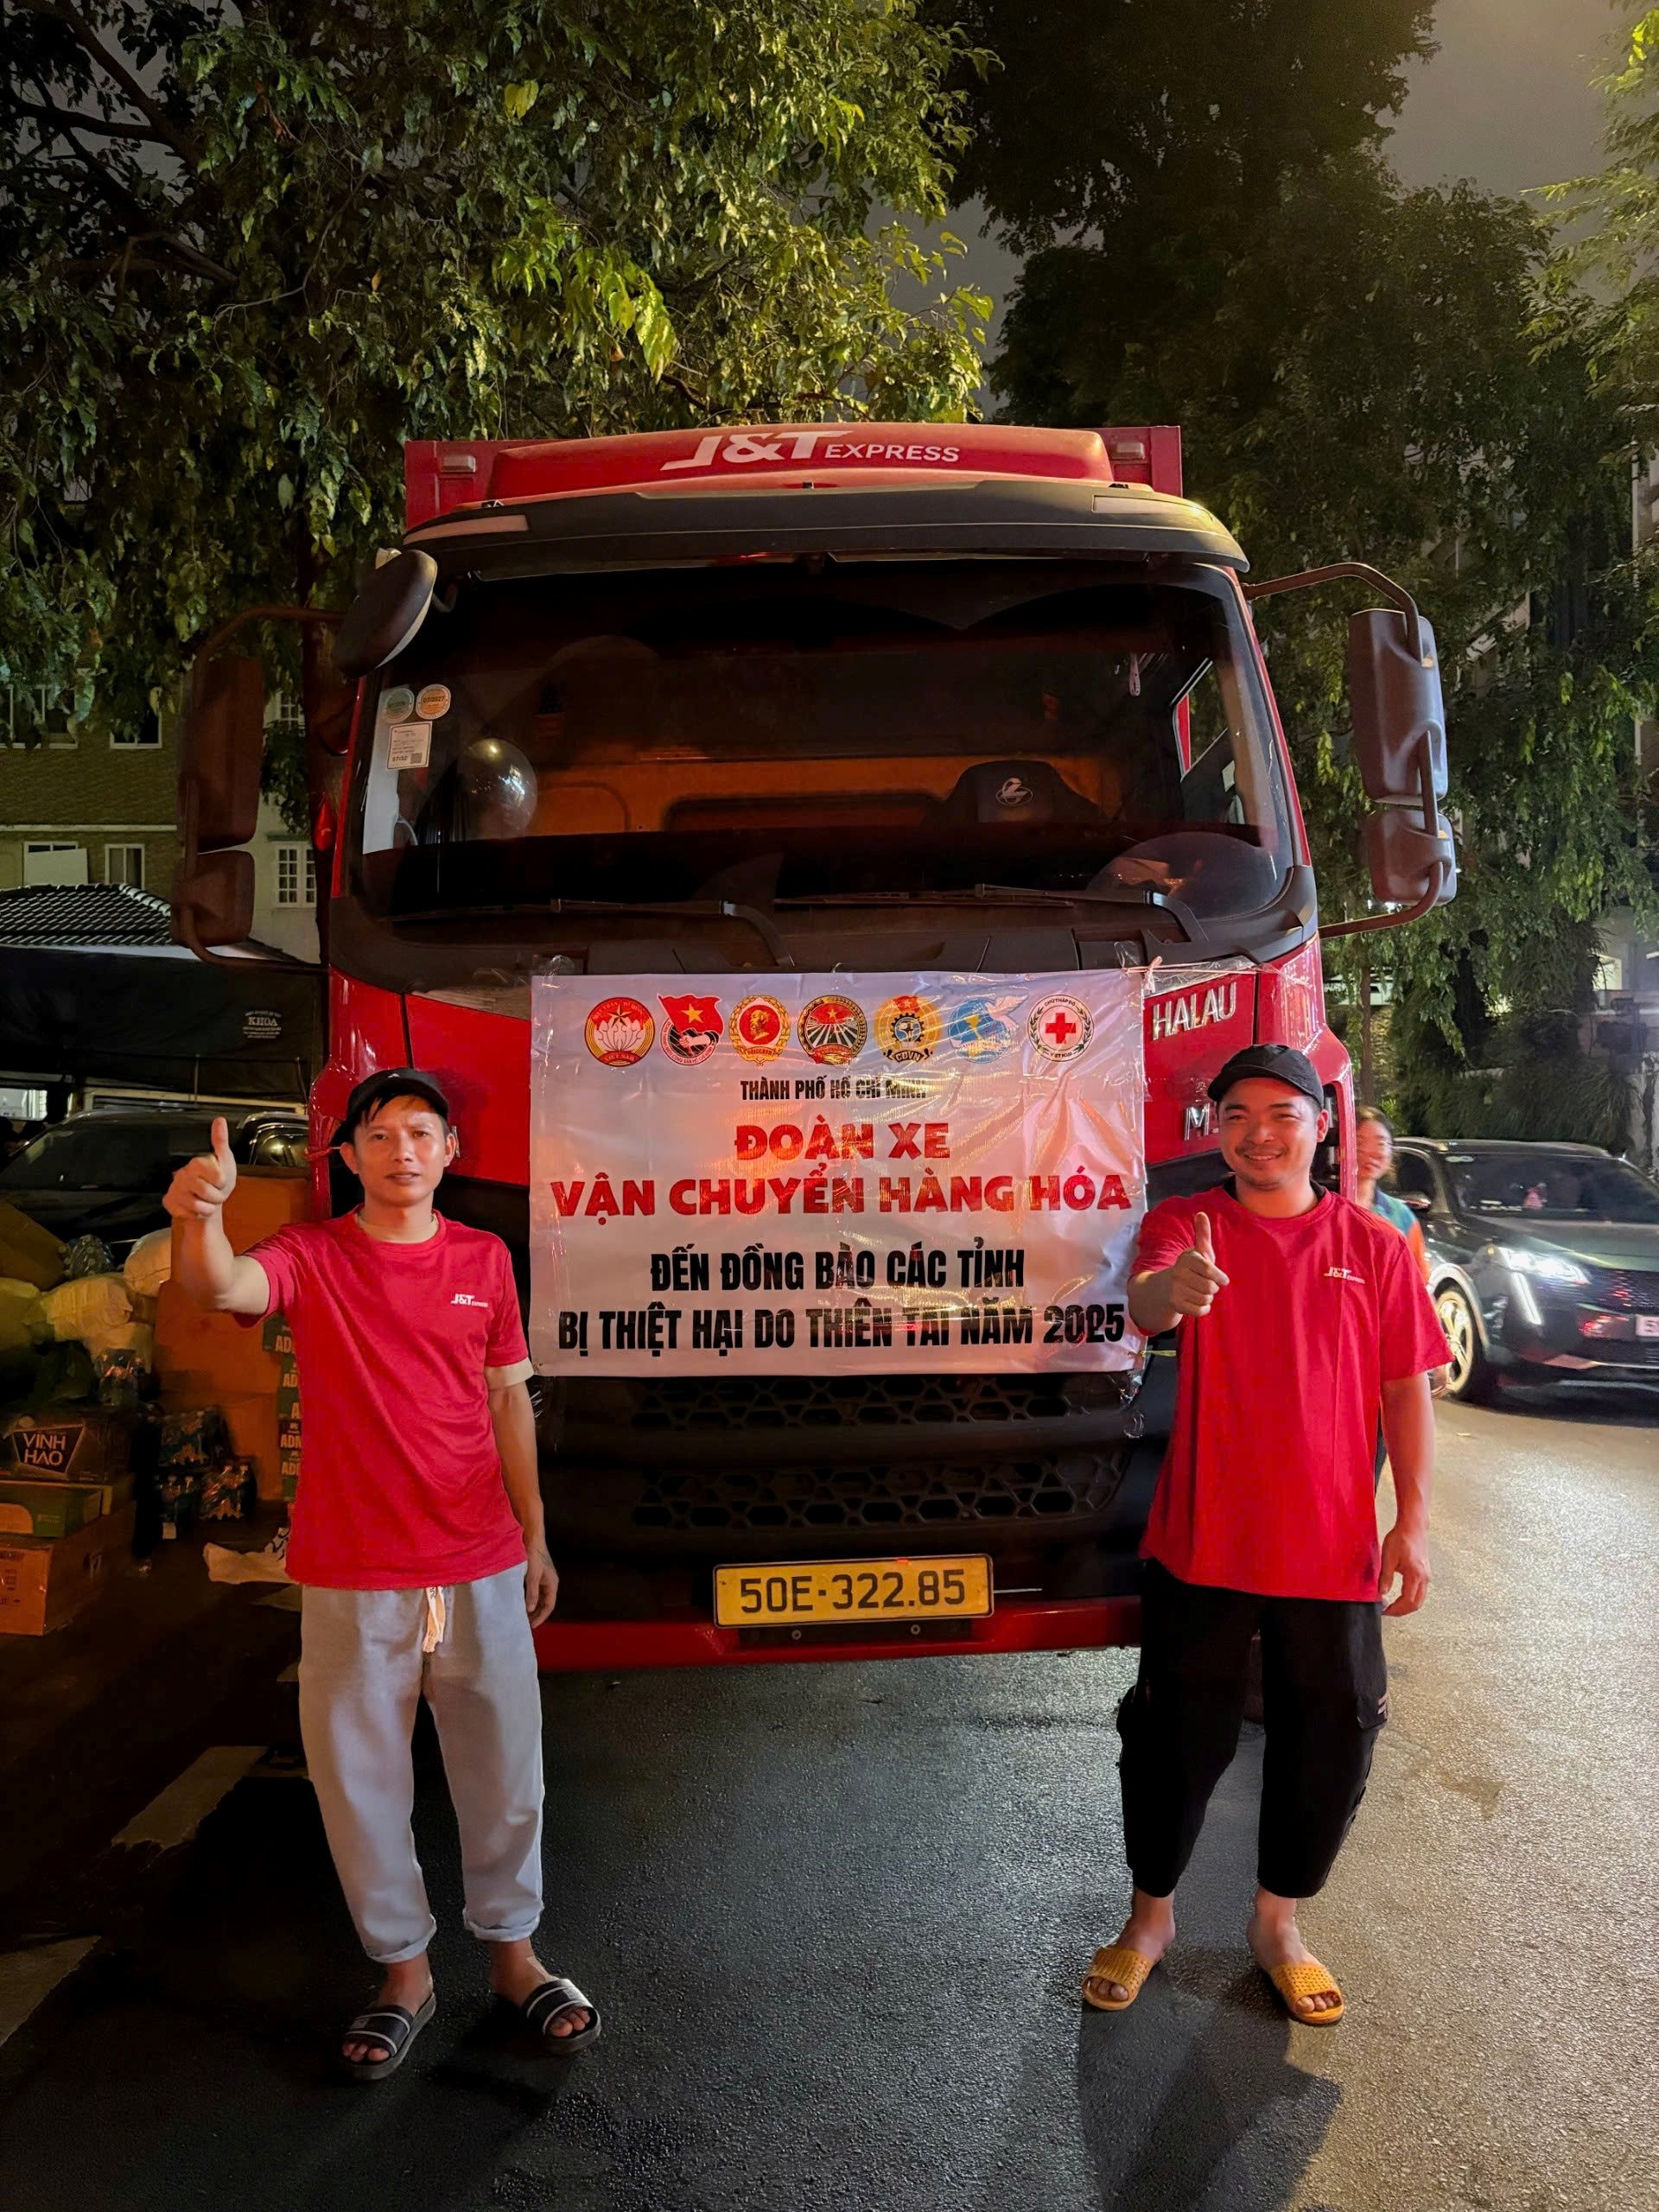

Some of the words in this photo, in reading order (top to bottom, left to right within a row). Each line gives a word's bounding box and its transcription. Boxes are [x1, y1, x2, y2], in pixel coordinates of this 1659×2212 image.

[660, 431, 852, 471] J&T
[824, 444, 961, 462] EXPRESS
[1152, 981, 1237, 1040] HALAU
[741, 1077, 790, 1100] THÀNH
[795, 1075, 827, 1099] PHỐ
[830, 1076, 851, 1099] HỒ
[734, 1114, 874, 1160] ĐOÀN
[888, 1122, 950, 1160] XE
[550, 1172, 655, 1225] VẬN
[669, 1162, 864, 1216] CHUYỂN
[879, 1167, 1014, 1212] HÀNG
[1028, 1166, 1132, 1211] HÓA
[651, 1243, 709, 1291] ĐẾN
[720, 1243, 804, 1291] ĐỒNG
[815, 1242, 875, 1289] BÀO
[887, 1241, 947, 1288] CÁC
[957, 1236, 1025, 1287] TỈNH
[1324, 1266, 1352, 1279] J&T
[450, 1293, 474, 1305] J&T
[559, 1311, 588, 1357] BỊ
[599, 1301, 682, 1357] THIỆT
[692, 1309, 744, 1357] HẠI
[754, 1308, 795, 1348] DO
[805, 1297, 893, 1347] THIÊN
[903, 1306, 950, 1346] TAI
[960, 1297, 1033, 1345] NĂM
[1043, 1303, 1125, 1344] 2025
[23, 1433, 67, 1450] VINH
[740, 1568, 965, 1614] 50E-322.85
